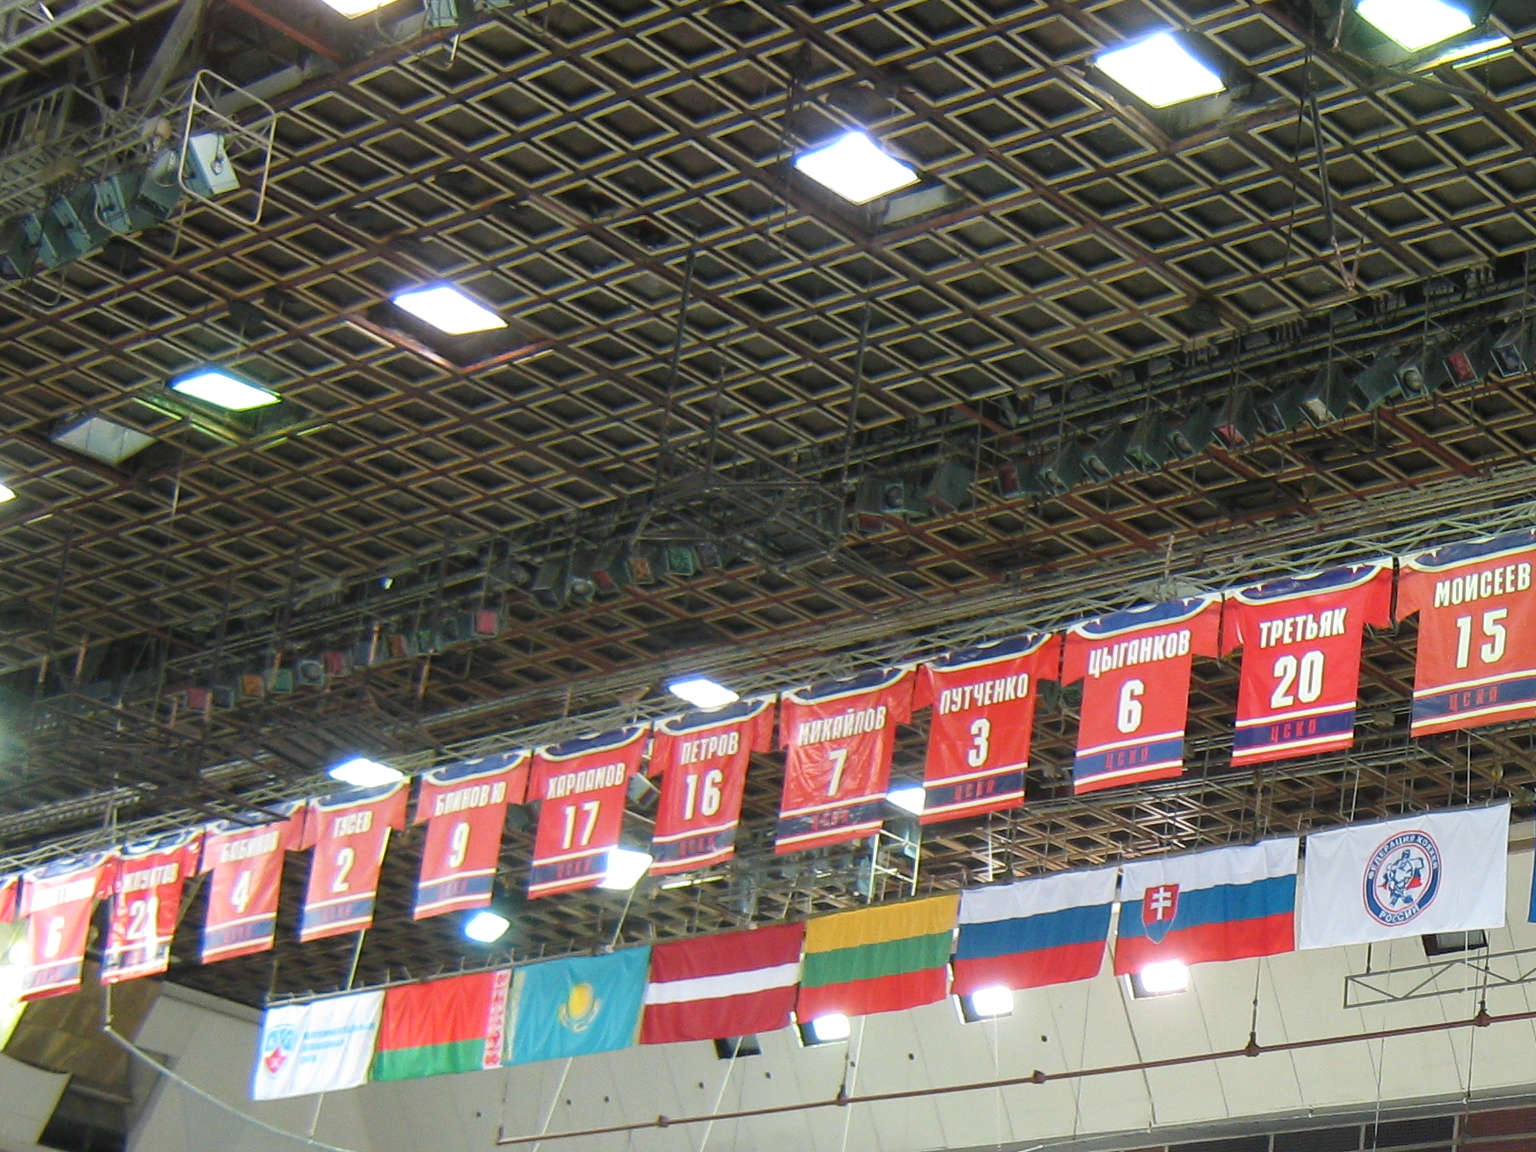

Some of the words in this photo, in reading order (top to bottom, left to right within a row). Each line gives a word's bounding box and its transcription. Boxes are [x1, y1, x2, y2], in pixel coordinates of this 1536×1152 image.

[1434, 562, 1532, 608] МОИСЕЕВ
[1259, 607, 1348, 649] ТРЕТЬЯК
[1455, 608, 1508, 669] 15
[1088, 629, 1191, 679] ЦЫГАНКОВ
[939, 672, 1029, 715] ПУТЧЕНКО
[1270, 649, 1325, 709] 20
[799, 706, 888, 746] МИХАЙЛОВ
[1116, 679, 1145, 734] 6
[680, 731, 740, 765] ПЕТРОВ
[967, 718, 991, 768] 3
[546, 763, 625, 800] ХАРЛАМОВ
[683, 769, 723, 820] 16
[827, 748, 848, 797] 7
[434, 784, 490, 817] БЛИНОВ
[448, 822, 470, 869] 9
[562, 800, 600, 850] 17
[230, 869, 252, 914] 4
[332, 847, 356, 893] 2
[1379, 904, 1421, 923] РОССИИ
